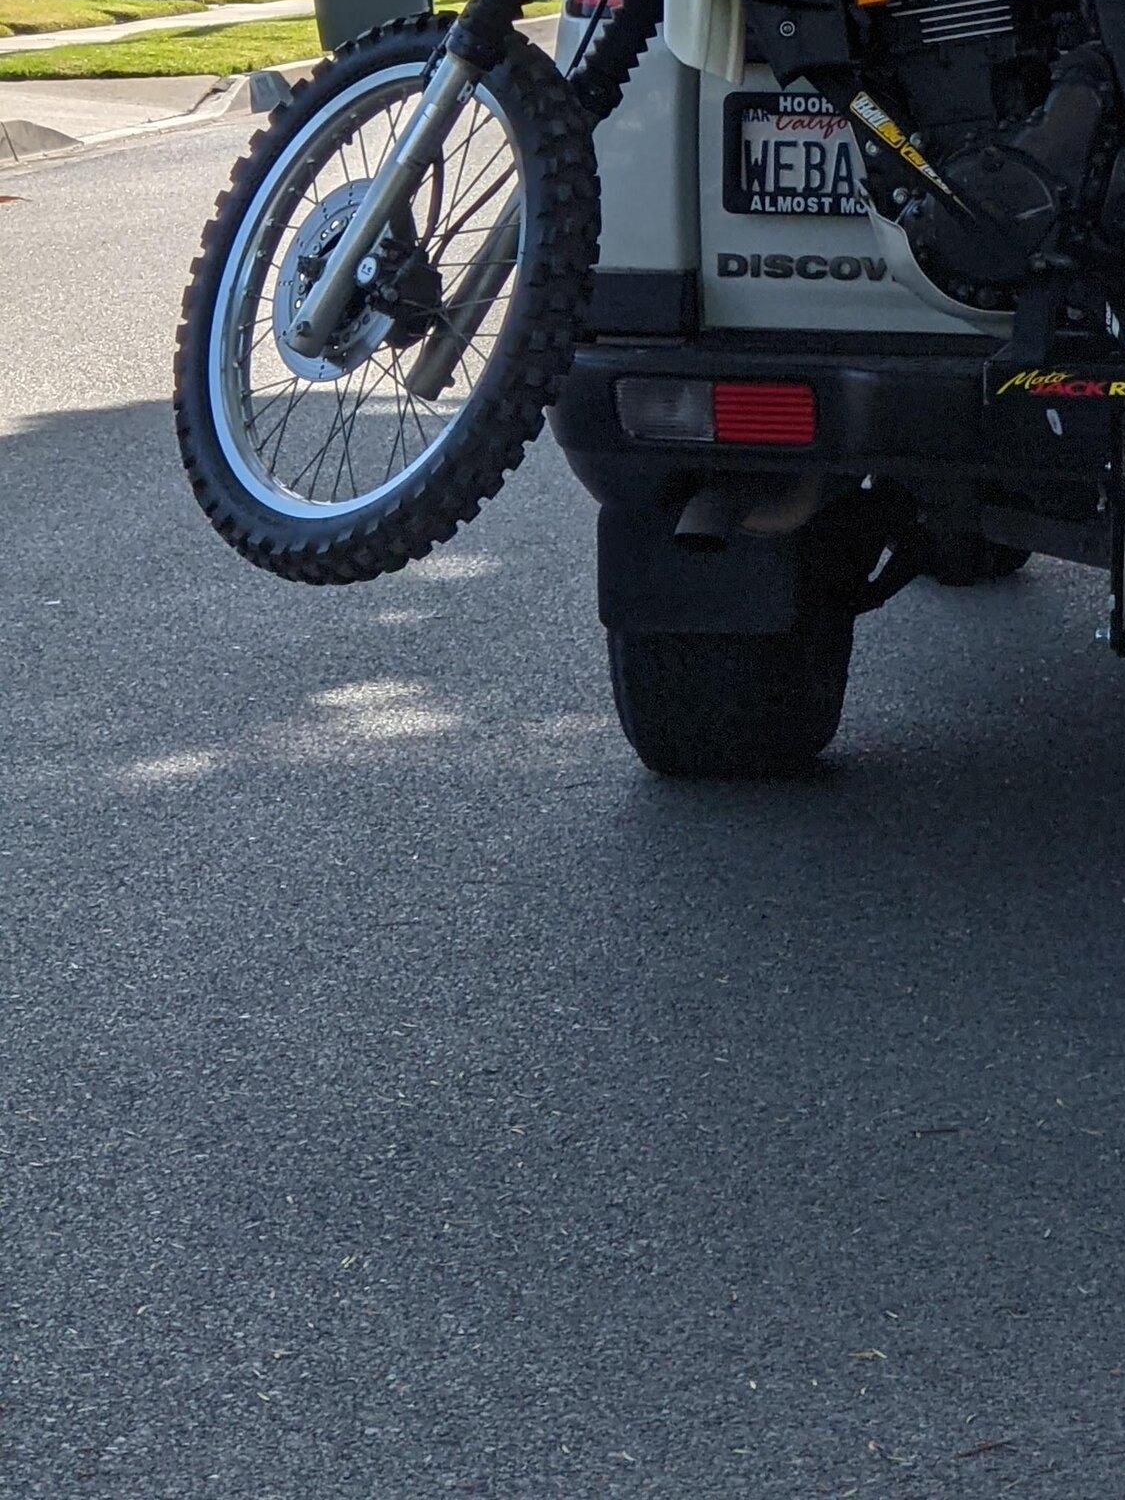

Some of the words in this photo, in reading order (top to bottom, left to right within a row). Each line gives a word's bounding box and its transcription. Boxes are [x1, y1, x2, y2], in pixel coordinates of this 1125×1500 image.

[744, 140, 854, 198] WEBA
[750, 195, 833, 213] ALMOST
[717, 253, 889, 281] DISCOV
[996, 369, 1074, 395] Moto
